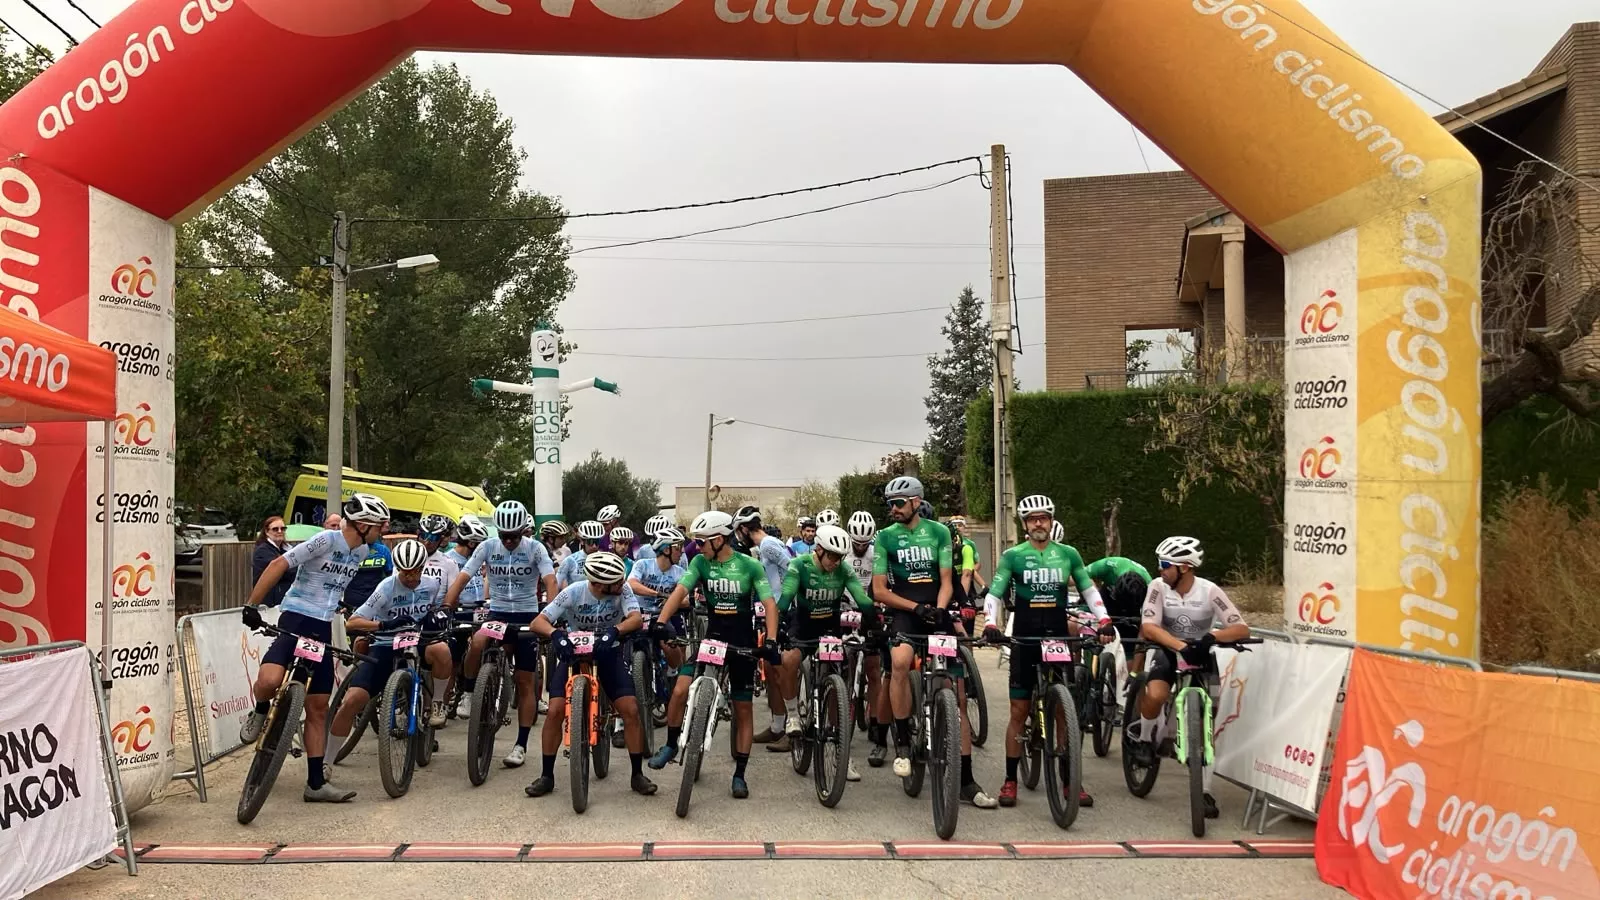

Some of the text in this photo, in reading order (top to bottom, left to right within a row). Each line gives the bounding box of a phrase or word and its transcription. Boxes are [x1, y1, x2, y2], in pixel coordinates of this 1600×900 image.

[37, 32, 176, 140] aragón
[1273, 50, 1425, 179] ciclismo
[99, 294, 161, 312] aragón ciclismo
[1315, 334, 1350, 343] ciclismo
[1386, 211, 1462, 474] aragón
[1295, 375, 1347, 397] aragón
[1294, 394, 1348, 409] ciclismo
[130, 446, 160, 457] ciclismo
[1315, 479, 1348, 489] ciclismo
[1294, 521, 1346, 542] aragón
[1294, 539, 1348, 556] ciclismo
[897, 546, 935, 563] PEDAL
[905, 562, 932, 571] STORE
[1023, 568, 1064, 585] PEDAL
[707, 578, 742, 594] PEDAL
[1030, 583, 1060, 592] STORE
[714, 592, 739, 600] STORE
[130, 598, 160, 608] ciclismo
[487, 623, 503, 632] 52
[1313, 626, 1348, 637] ciclismo
[302, 642, 319, 653] 23
[573, 637, 589, 646] 29
[939, 638, 947, 647] 7
[708, 646, 717, 655] 8
[824, 644, 840, 653] 14
[130, 752, 160, 764] ciclismo
[0, 759, 81, 831] AGON
[1437, 794, 1578, 872] aragón
[1401, 840, 1561, 900] ciclism
